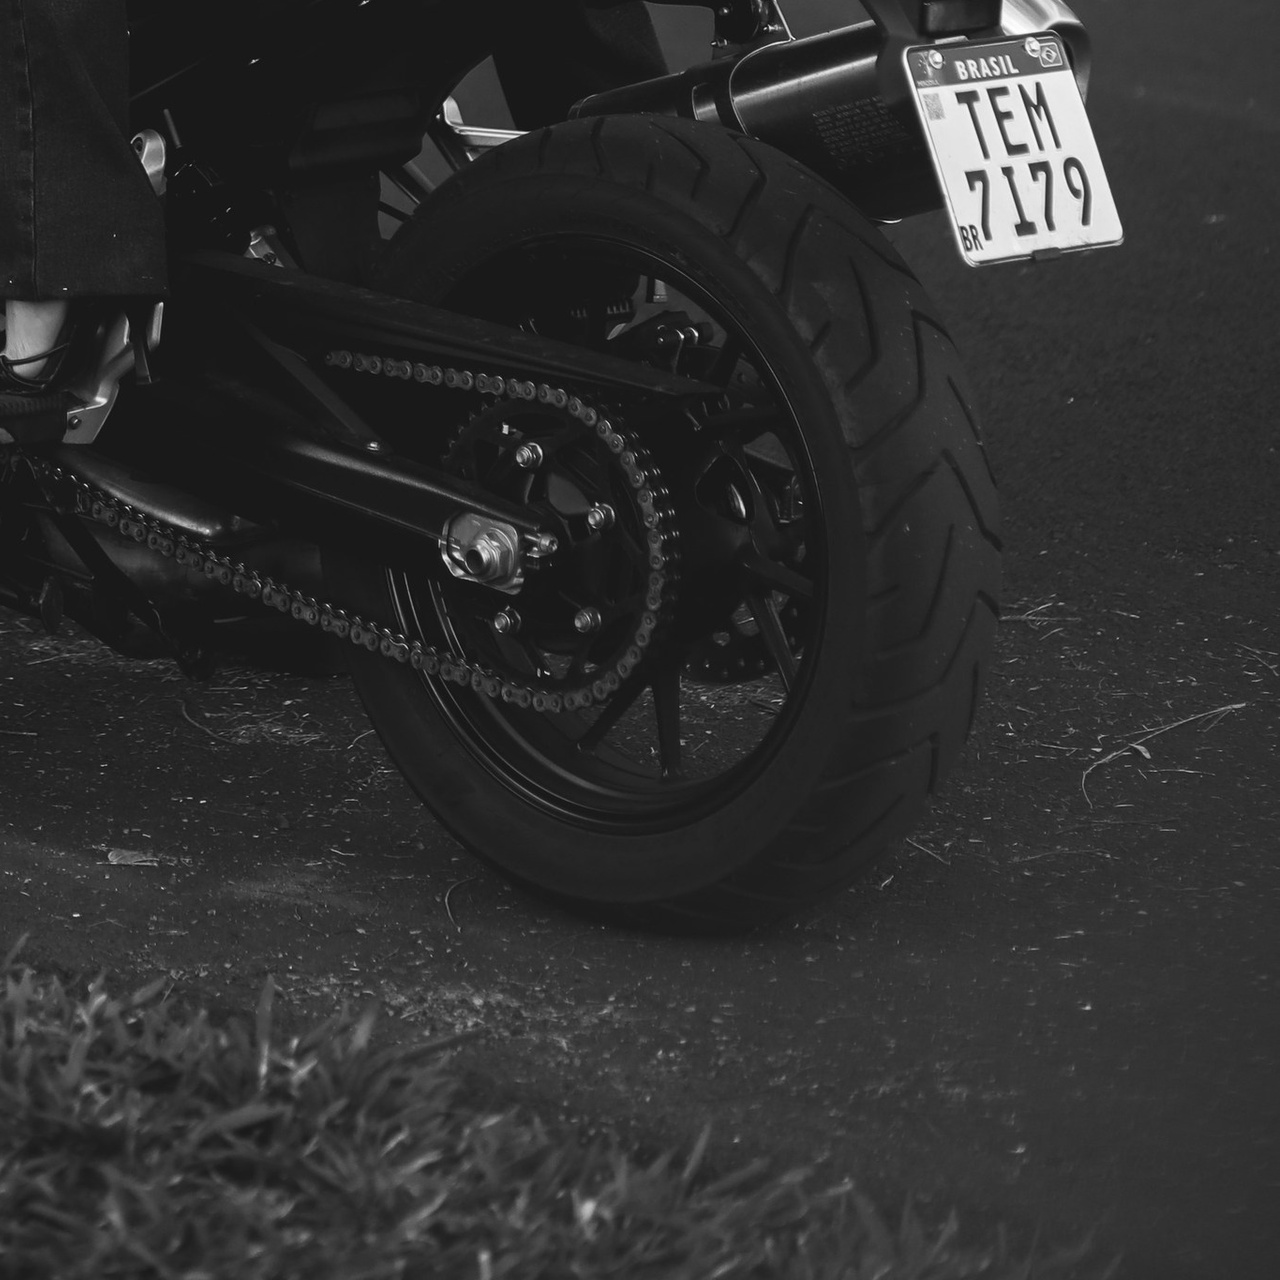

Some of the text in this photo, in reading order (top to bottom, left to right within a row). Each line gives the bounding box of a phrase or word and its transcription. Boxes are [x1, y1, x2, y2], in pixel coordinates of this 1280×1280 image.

[955, 55, 1019, 80] BRASIL
[955, 81, 1061, 160] TEM
[960, 225, 983, 251] BR
